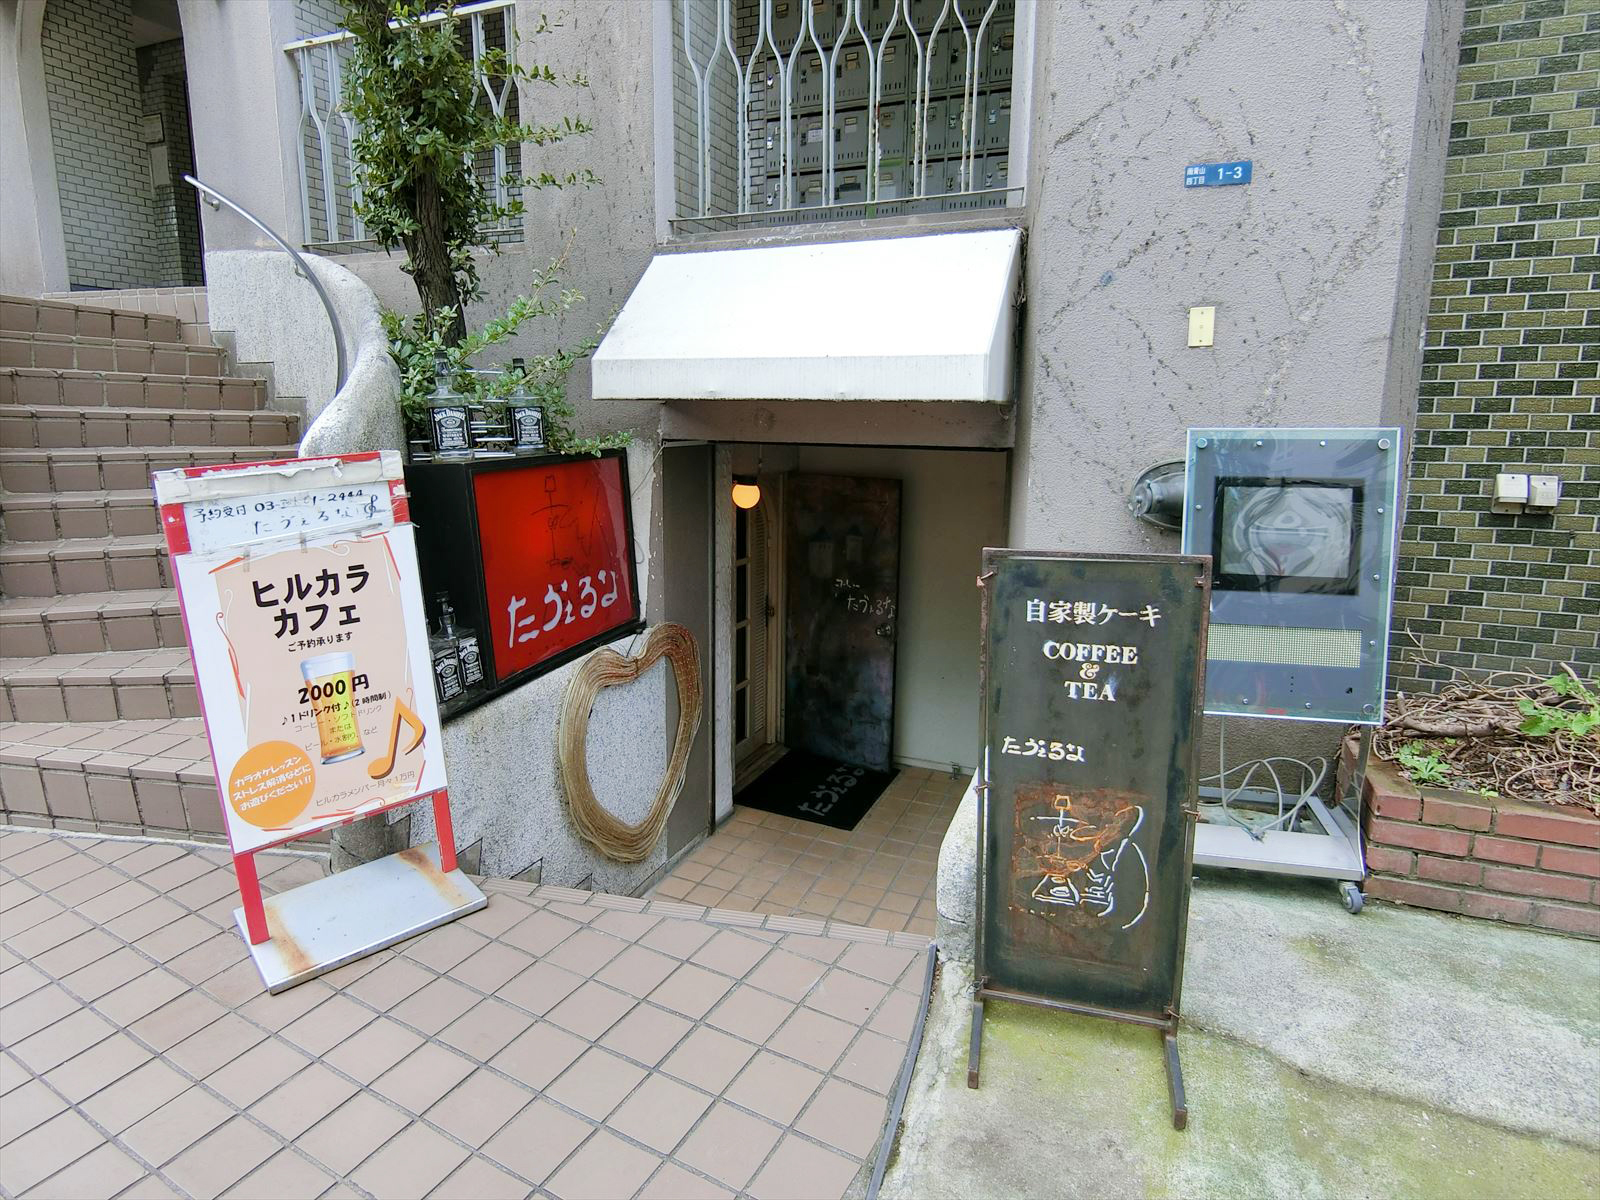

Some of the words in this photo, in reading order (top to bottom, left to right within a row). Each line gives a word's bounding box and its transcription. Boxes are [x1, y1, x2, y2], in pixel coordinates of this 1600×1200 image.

[1217, 166, 1242, 180] 1-3
[193, 505, 247, 524] 予約受付
[252, 563, 371, 608] ヒルカラ
[273, 604, 361, 639] カフェ
[1025, 599, 1162, 628] 自家製ケーキ
[288, 631, 353, 652] ご予約承ります
[1042, 640, 1138, 666] COFFEE
[1079, 662, 1100, 680] &
[1064, 680, 1117, 702] TEA
[329, 722, 352, 735] または
[233, 764, 312, 802] ストレス解消などに
[234, 755, 302, 788] カラオケレッスン
